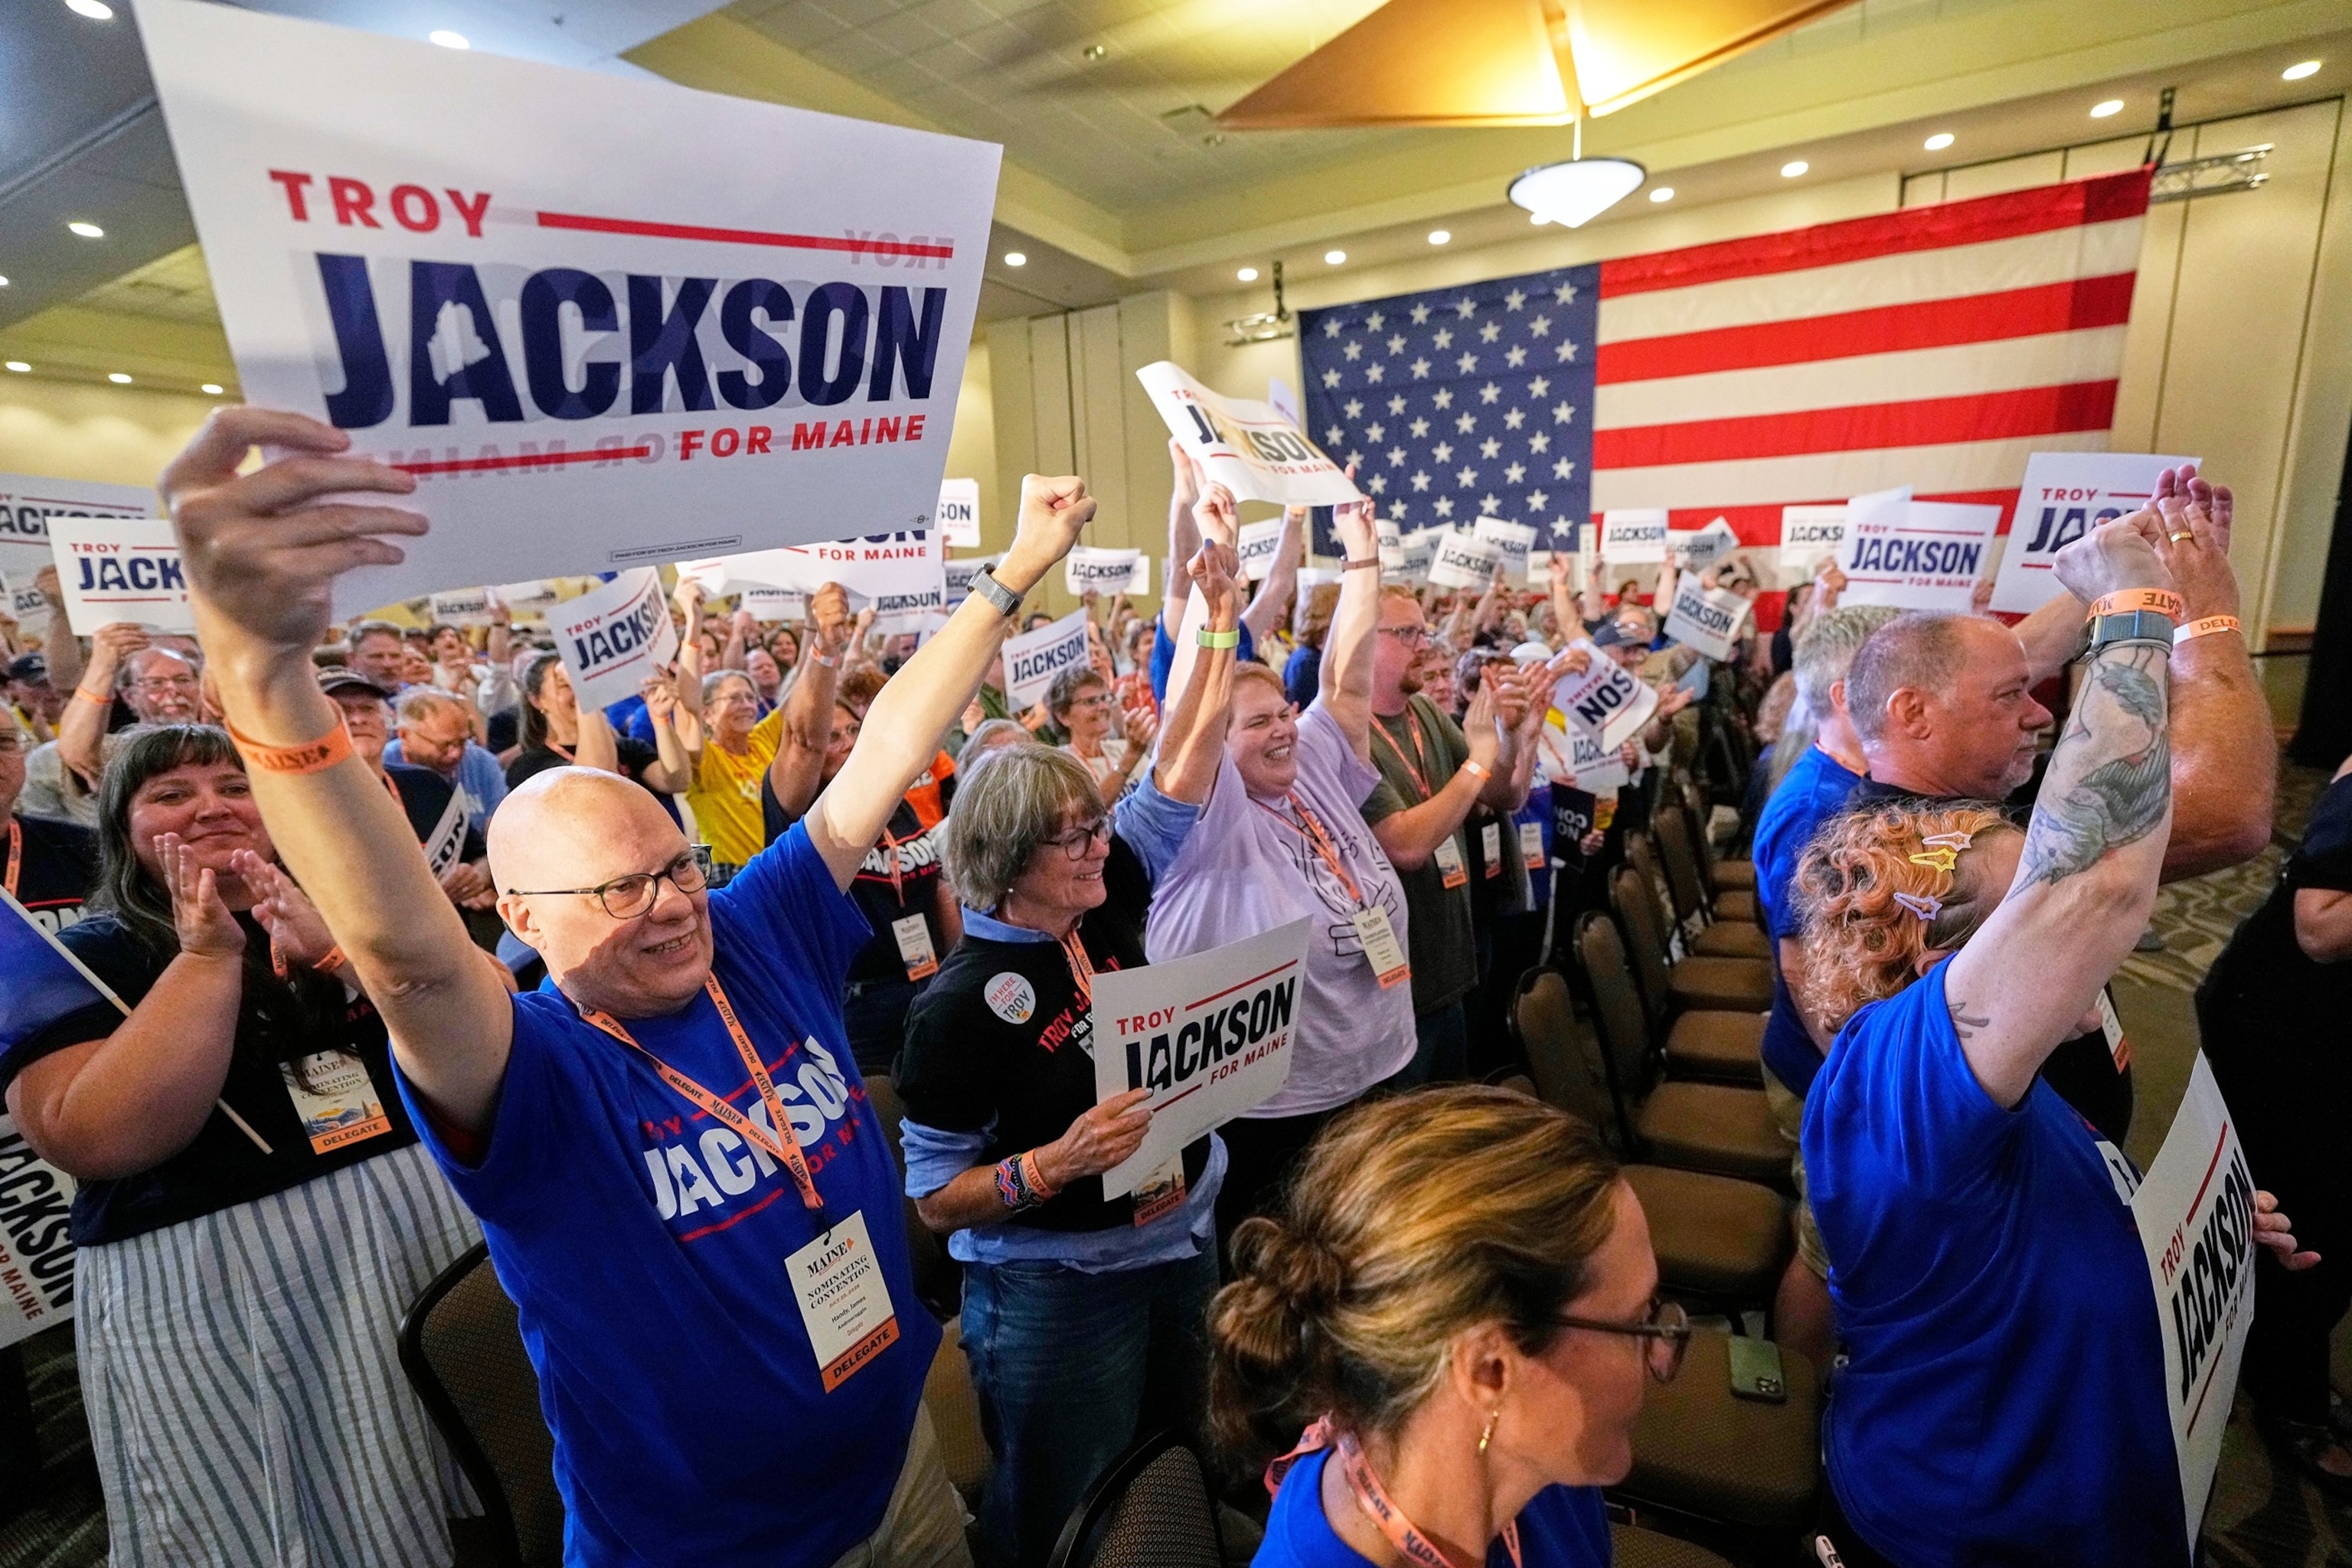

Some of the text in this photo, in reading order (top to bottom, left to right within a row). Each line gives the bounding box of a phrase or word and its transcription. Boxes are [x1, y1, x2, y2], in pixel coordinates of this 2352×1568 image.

[269, 169, 492, 238] TROY
[315, 251, 948, 430] JACKSON
[680, 414, 926, 461] FOR MAINE
[1270, 464, 1298, 475] FOR
[2042, 488, 2099, 501] TROY
[1790, 524, 1845, 542] JACKS
[1857, 524, 1889, 534] TROY
[70, 543, 121, 553] TROY
[818, 546, 927, 561] FOR MAINE
[1850, 537, 1982, 574] JACKSON
[1072, 563, 1133, 578] JACKSON
[1908, 576, 1931, 586] FOR
[566, 615, 602, 637] TROY
[573, 581, 665, 671] JACKSON
[2200, 618, 2238, 631] DELE
[1012, 632, 1086, 684] JACKSON
[988, 976, 1016, 1005] I'M HERE
[1001, 990, 1015, 1005] FOR
[1003, 989, 1031, 1020] TROY
[1037, 1008, 1074, 1054] TROY
[1070, 1020, 1089, 1039] FOR
[1116, 1006, 1175, 1036] TROY
[1125, 975, 1296, 1096] JACKSON
[737, 1034, 756, 1064] DELEGATE
[1210, 1032, 1288, 1086] FOR MAINE
[668, 1073, 704, 1100] DELEGATE
[710, 1099, 740, 1125] MAINE
[774, 1108, 793, 1145] DELEGATE
[322, 1122, 381, 1147] DELEGATE
[749, 1129, 779, 1155] DELEGATE
[806, 1142, 837, 1174] OR
[1141, 1194, 1181, 1220] DELEGATE
[807, 1241, 848, 1279] MAINE
[2160, 1222, 2187, 1287] TROY
[807, 1254, 868, 1301] NOMINATING
[810, 1263, 871, 1310] CONVENTION
[2171, 1146, 2255, 1406] JACKSON
[1, 1267, 44, 1321] MAINE
[831, 1295, 867, 1324] Handy, James
[838, 1307, 867, 1331] Androscoggin
[2226, 1293, 2239, 1341] FOR
[847, 1321, 864, 1337] Delegate
[833, 1328, 890, 1379] DELEGATE
[1355, 1467, 1392, 1521] DELEGATE
